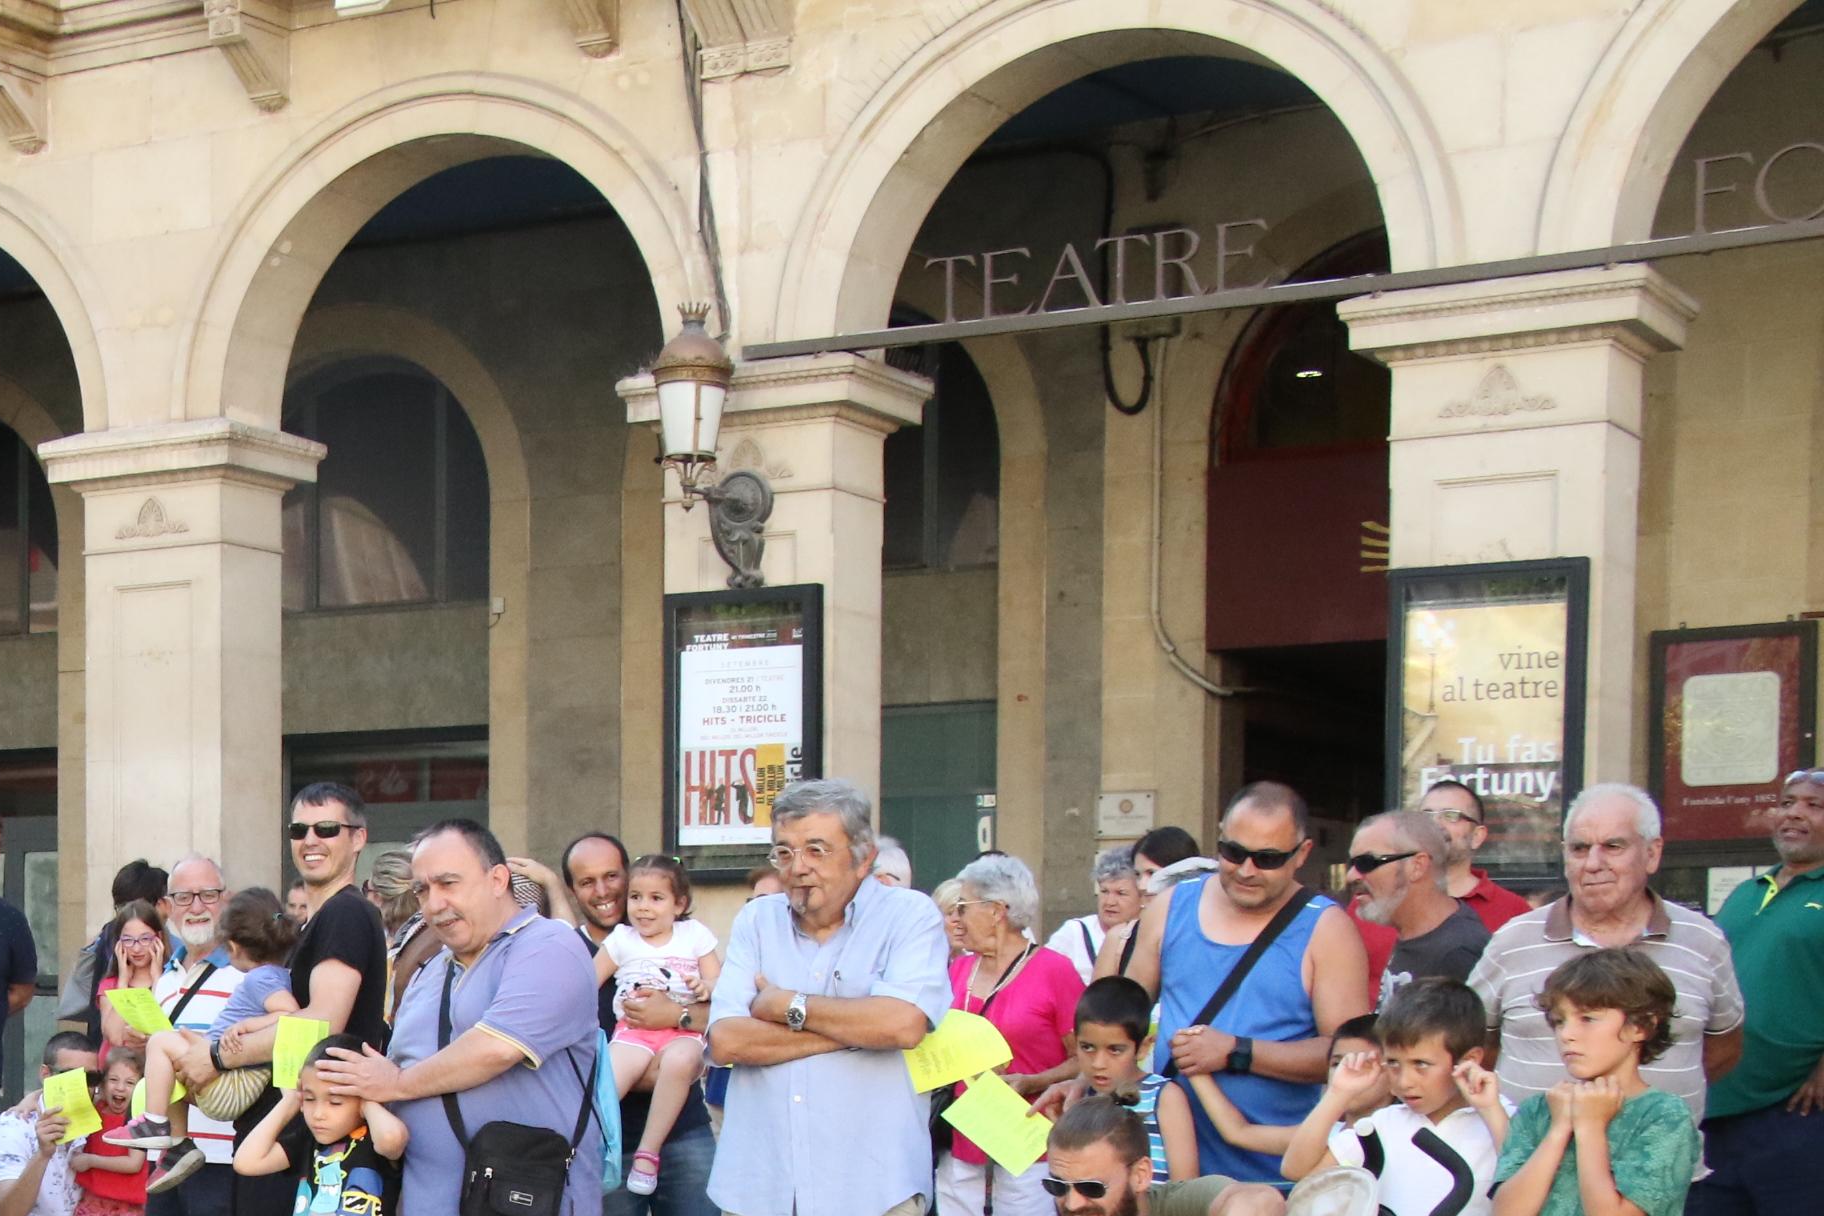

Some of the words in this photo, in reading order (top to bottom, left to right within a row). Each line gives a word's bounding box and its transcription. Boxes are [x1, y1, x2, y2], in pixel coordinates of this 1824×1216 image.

[924, 217, 1276, 324] TEATRE
[694, 634, 730, 643] TEATRE
[1498, 645, 1560, 671] vine
[729, 684, 754, 693] 21.00
[1442, 676, 1466, 702] al
[1473, 676, 1559, 700] teatre
[702, 716, 727, 726] HITS
[739, 713, 787, 724] TRICICLE
[712, 705, 737, 714] 18.30
[744, 704, 769, 712] 21.00
[1457, 736, 1497, 765] Tu
[1510, 733, 1557, 763] fas
[684, 747, 757, 826] HITS
